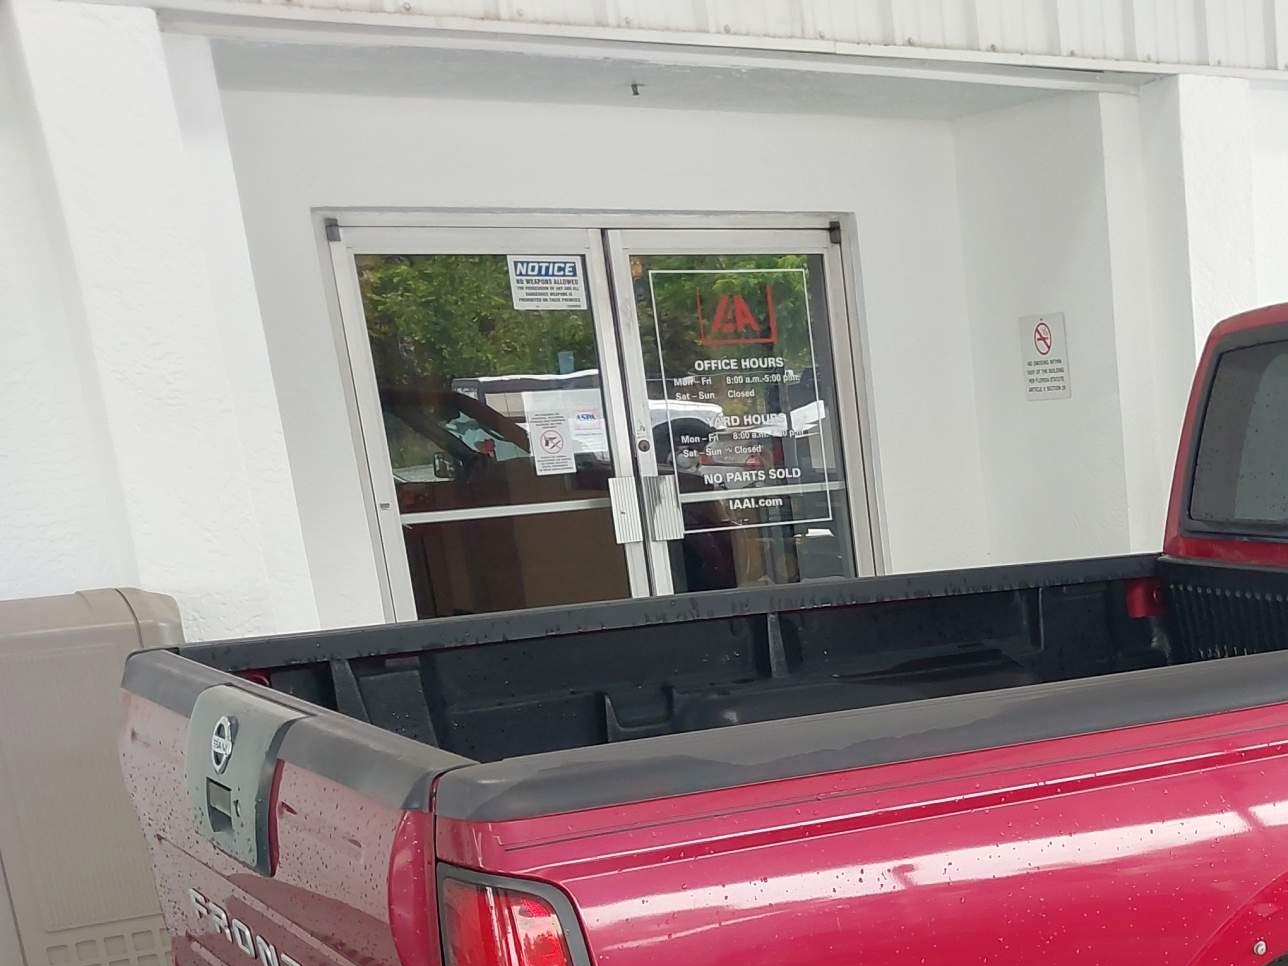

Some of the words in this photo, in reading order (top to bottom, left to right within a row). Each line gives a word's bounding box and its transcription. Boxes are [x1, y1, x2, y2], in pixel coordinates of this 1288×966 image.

[516, 262, 575, 276] NOTICE
[694, 358, 738, 371] OFFICE
[741, 357, 784, 369] HOURS
[701, 377, 712, 386] Fri
[675, 392, 691, 401] Sat
[698, 391, 716, 400] Sun
[727, 389, 755, 399] Closed
[706, 415, 740, 428] YARD
[743, 413, 787, 426] HOURS
[680, 435, 700, 444] Mon
[708, 434, 719, 442] Fri
[732, 431, 750, 440] 8:00
[682, 449, 698, 458] Sat
[705, 448, 722, 456] Sun
[734, 445, 762, 454] Closed
[703, 473, 723, 485] NO
[726, 470, 766, 482] PARTS
[769, 468, 801, 479] SOLD
[729, 496, 783, 510] IAAI.com
